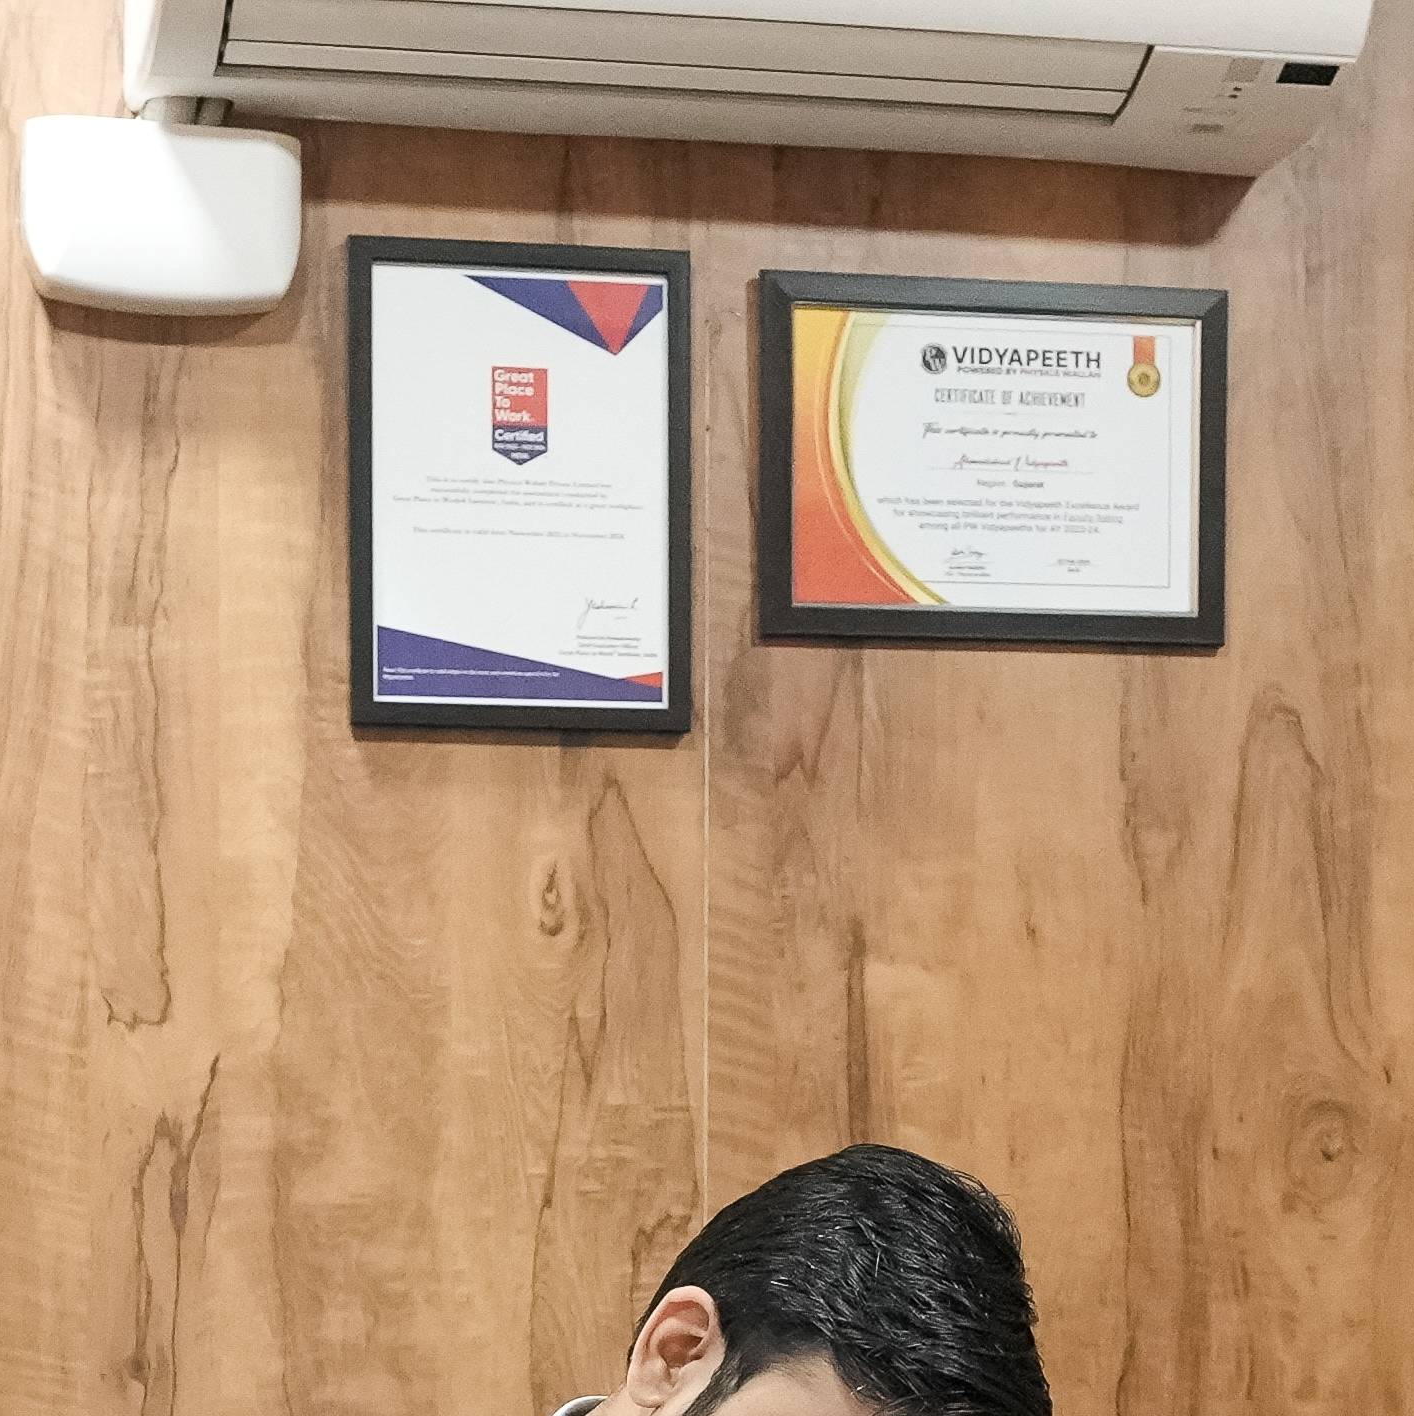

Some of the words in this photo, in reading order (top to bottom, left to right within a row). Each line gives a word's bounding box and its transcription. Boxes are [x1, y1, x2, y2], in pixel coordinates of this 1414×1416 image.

[952, 345, 1102, 369] VIDYAPEETH
[494, 369, 534, 383] Great
[494, 382, 534, 396] Place
